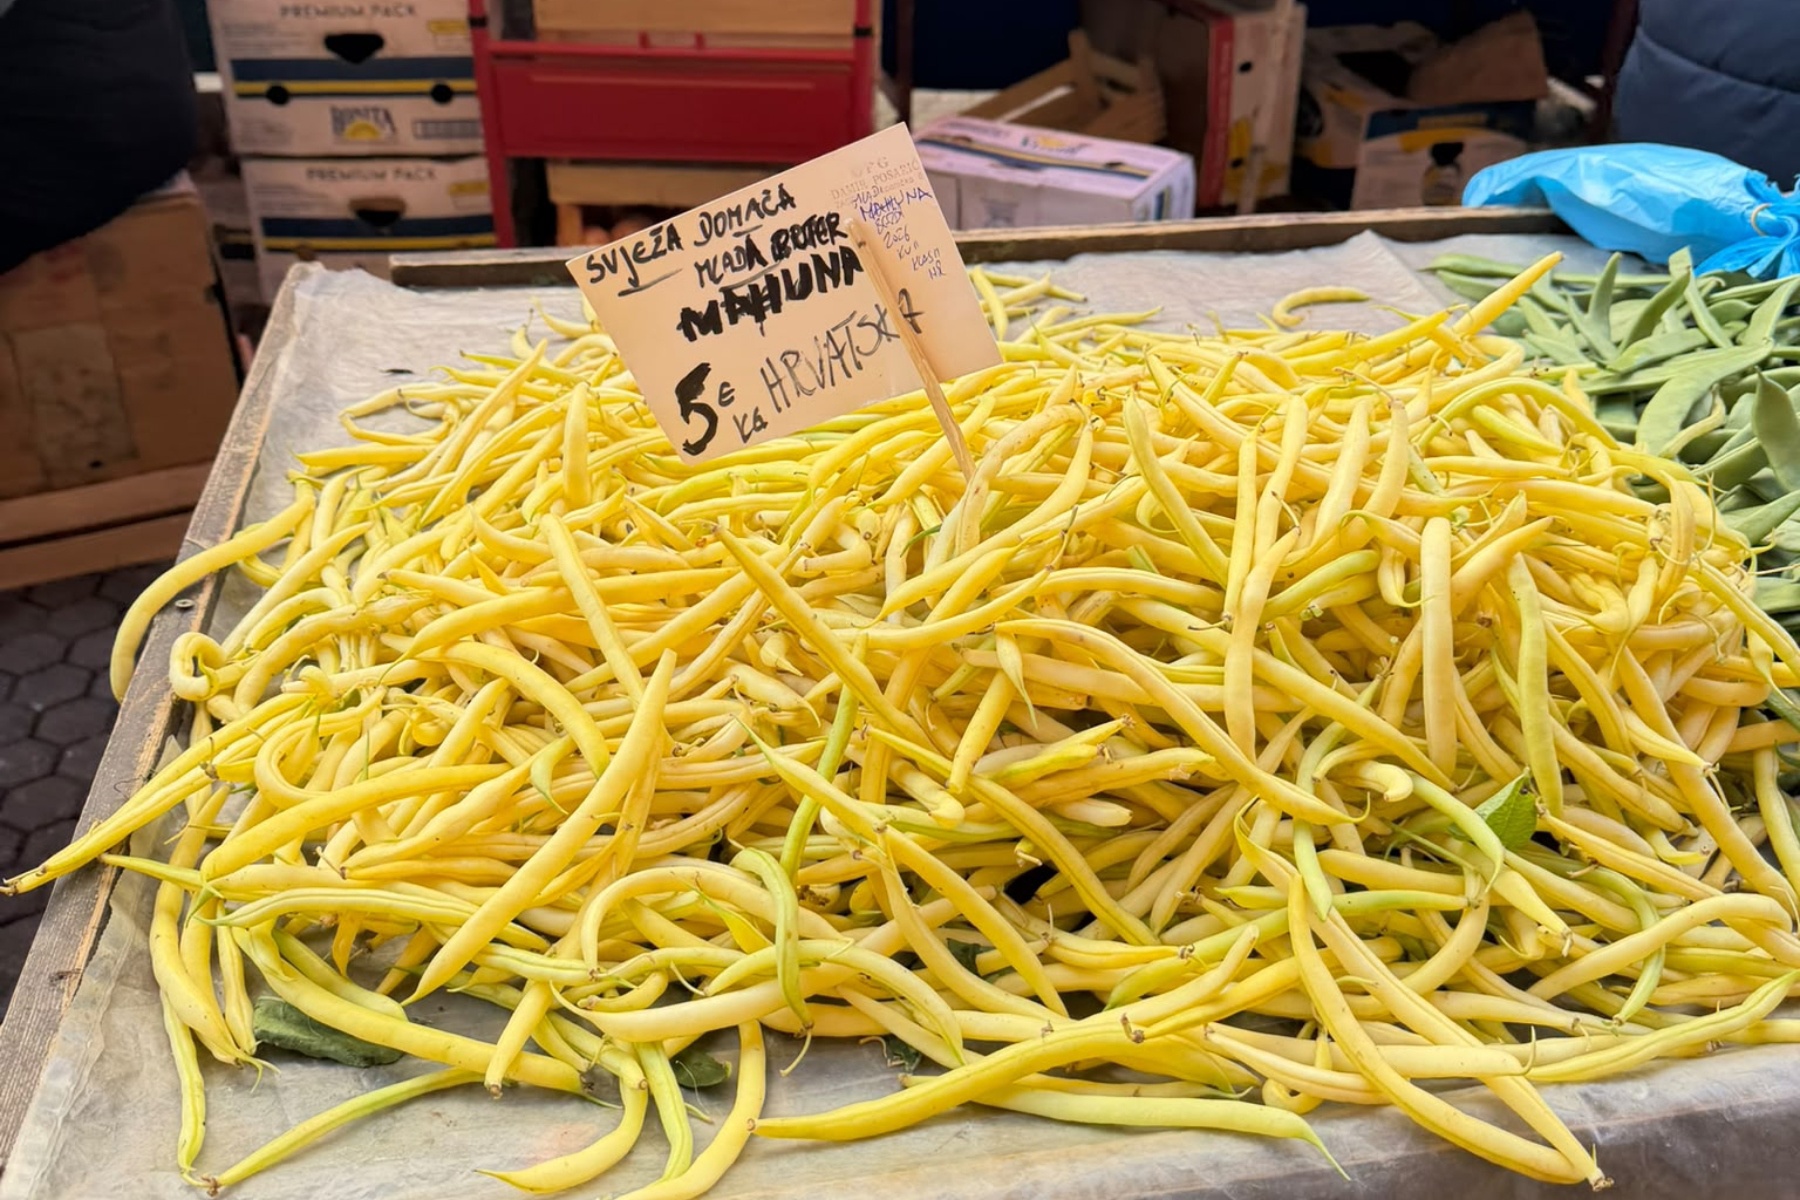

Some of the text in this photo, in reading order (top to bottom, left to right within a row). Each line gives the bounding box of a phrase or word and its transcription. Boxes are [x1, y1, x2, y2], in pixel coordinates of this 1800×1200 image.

[280, 4, 417, 19] PREMIUM PACK
[306, 168, 437, 182] PREMIUM PACK
[694, 234, 768, 288] MLADA
[677, 246, 864, 342] MAHUNA
